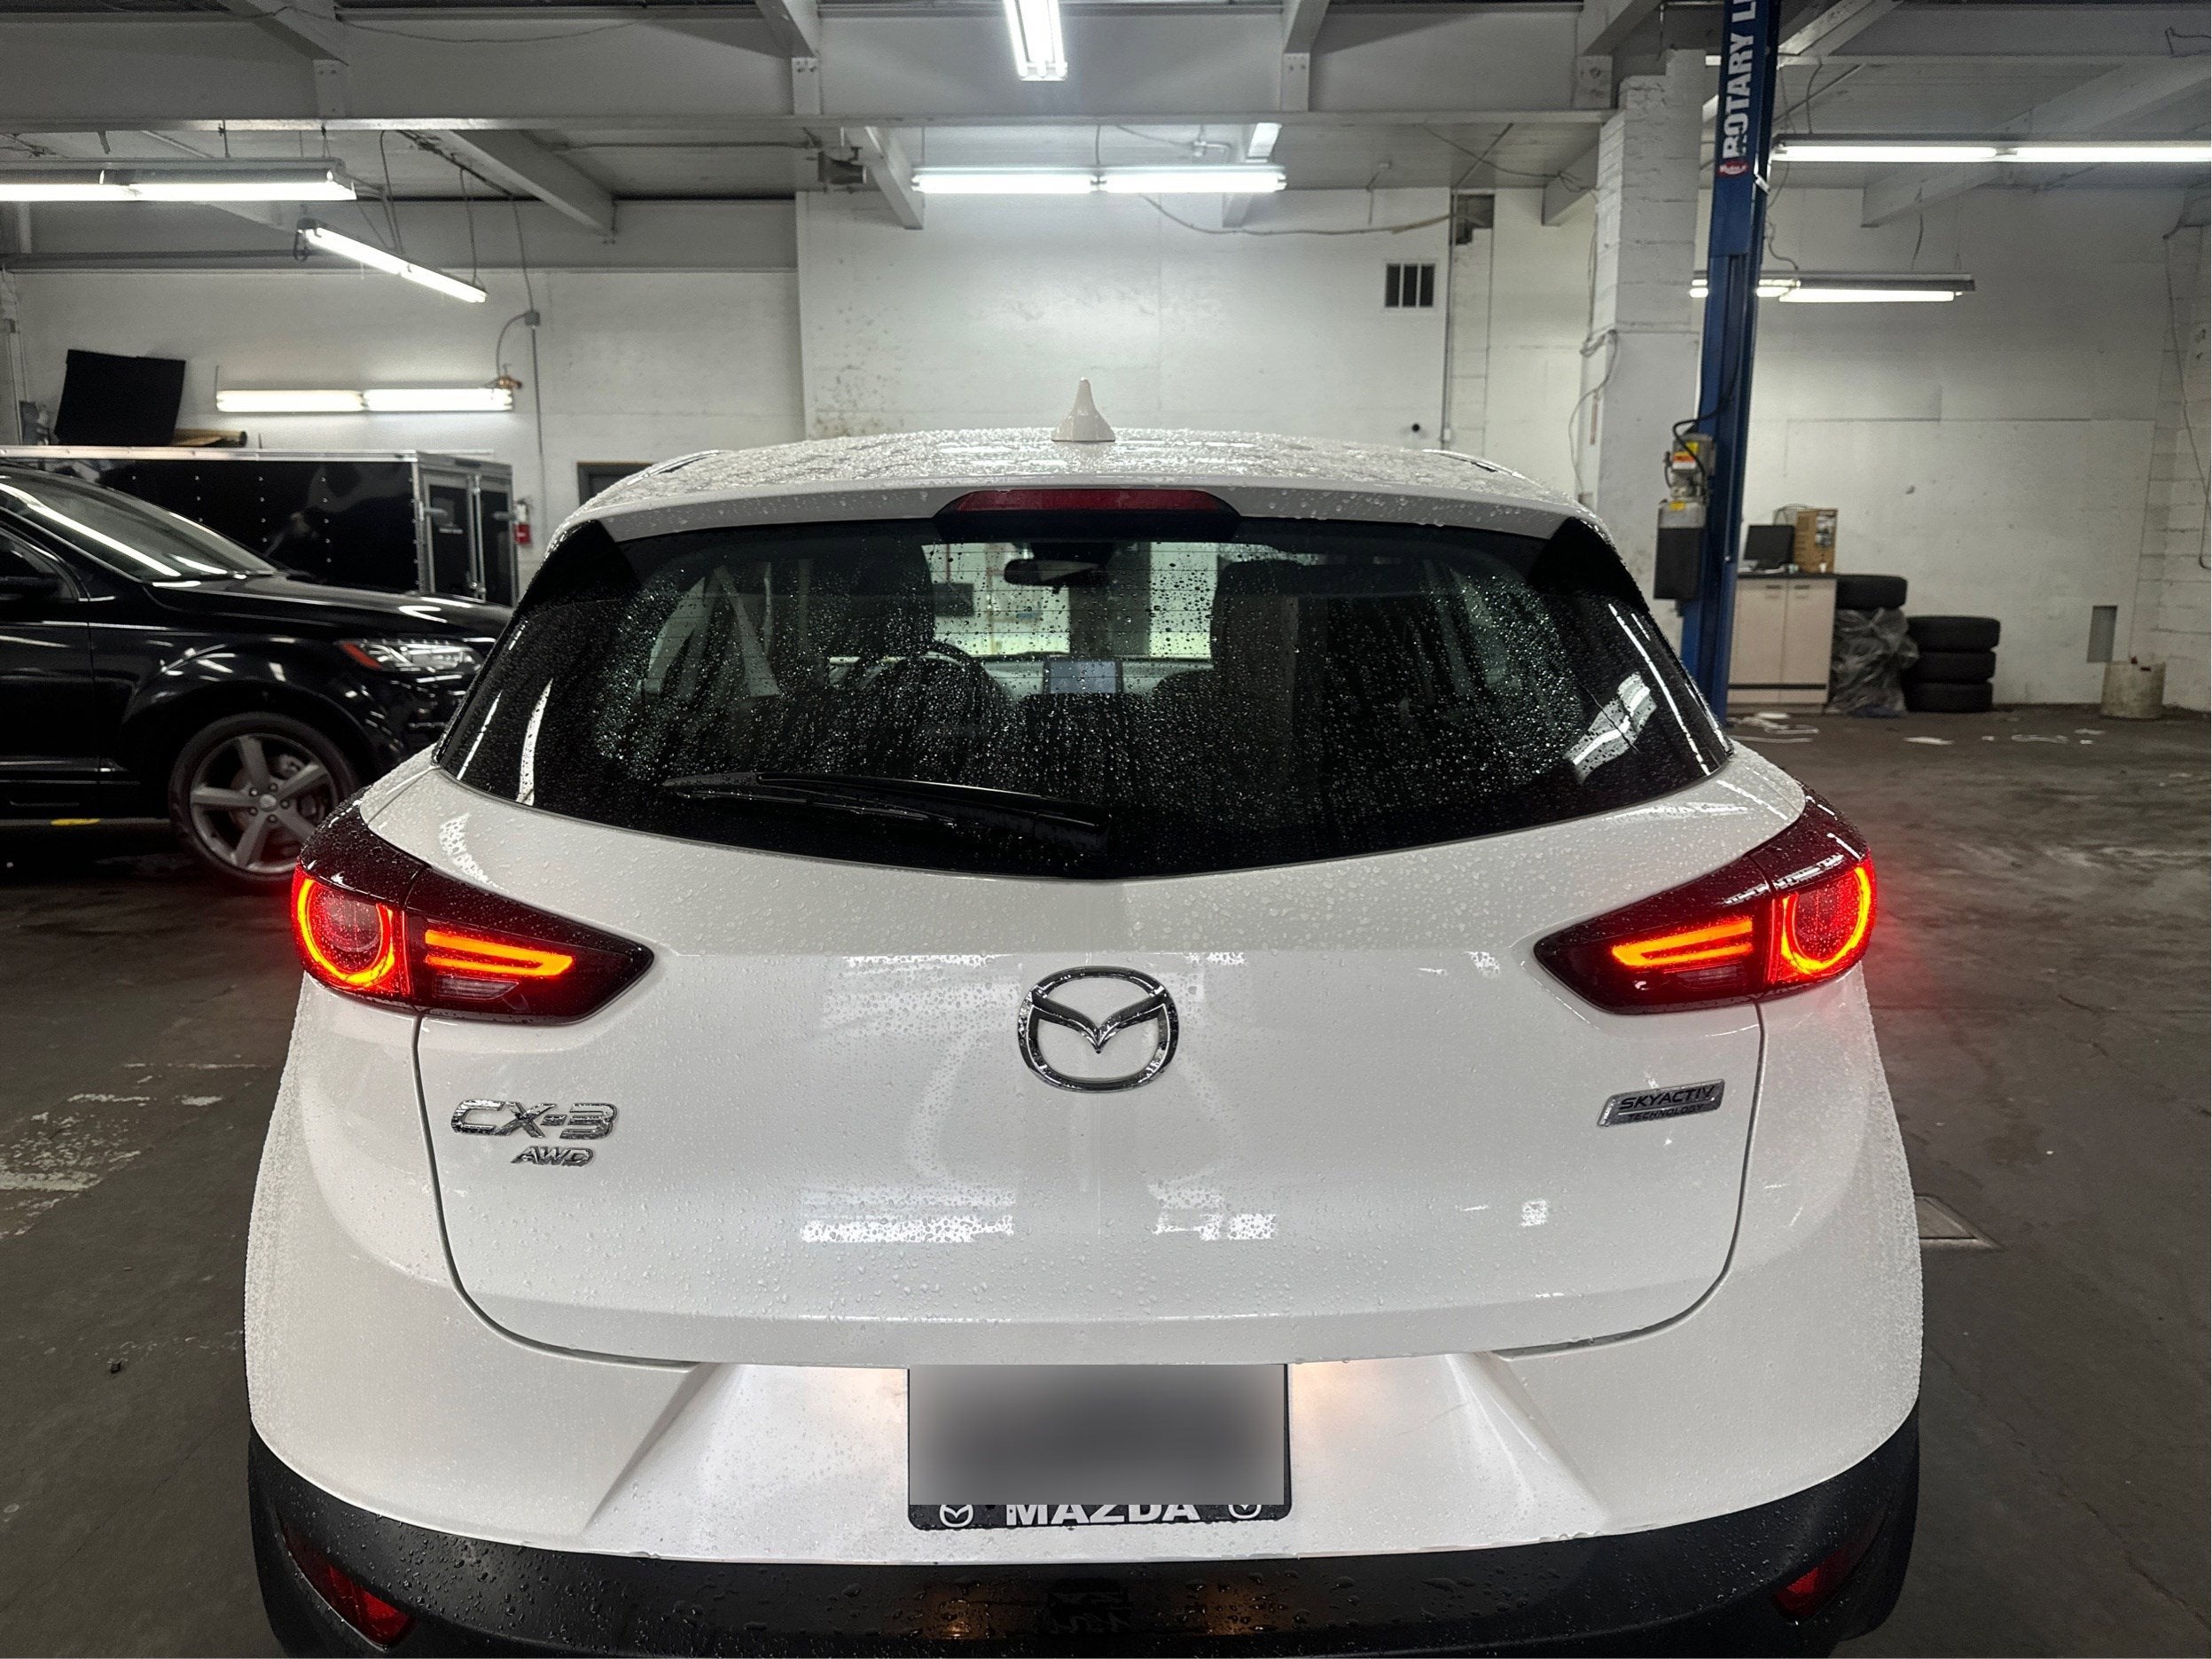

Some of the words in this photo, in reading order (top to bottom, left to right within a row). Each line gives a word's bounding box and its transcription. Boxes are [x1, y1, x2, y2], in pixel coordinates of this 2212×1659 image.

[1722, 33, 1755, 159] ROTARY
[1618, 1085, 1716, 1109] SKYACTIV
[451, 1099, 617, 1139] CX-3
[1629, 1104, 1705, 1122] TECHNOLOGY
[511, 1146, 593, 1167] AWD
